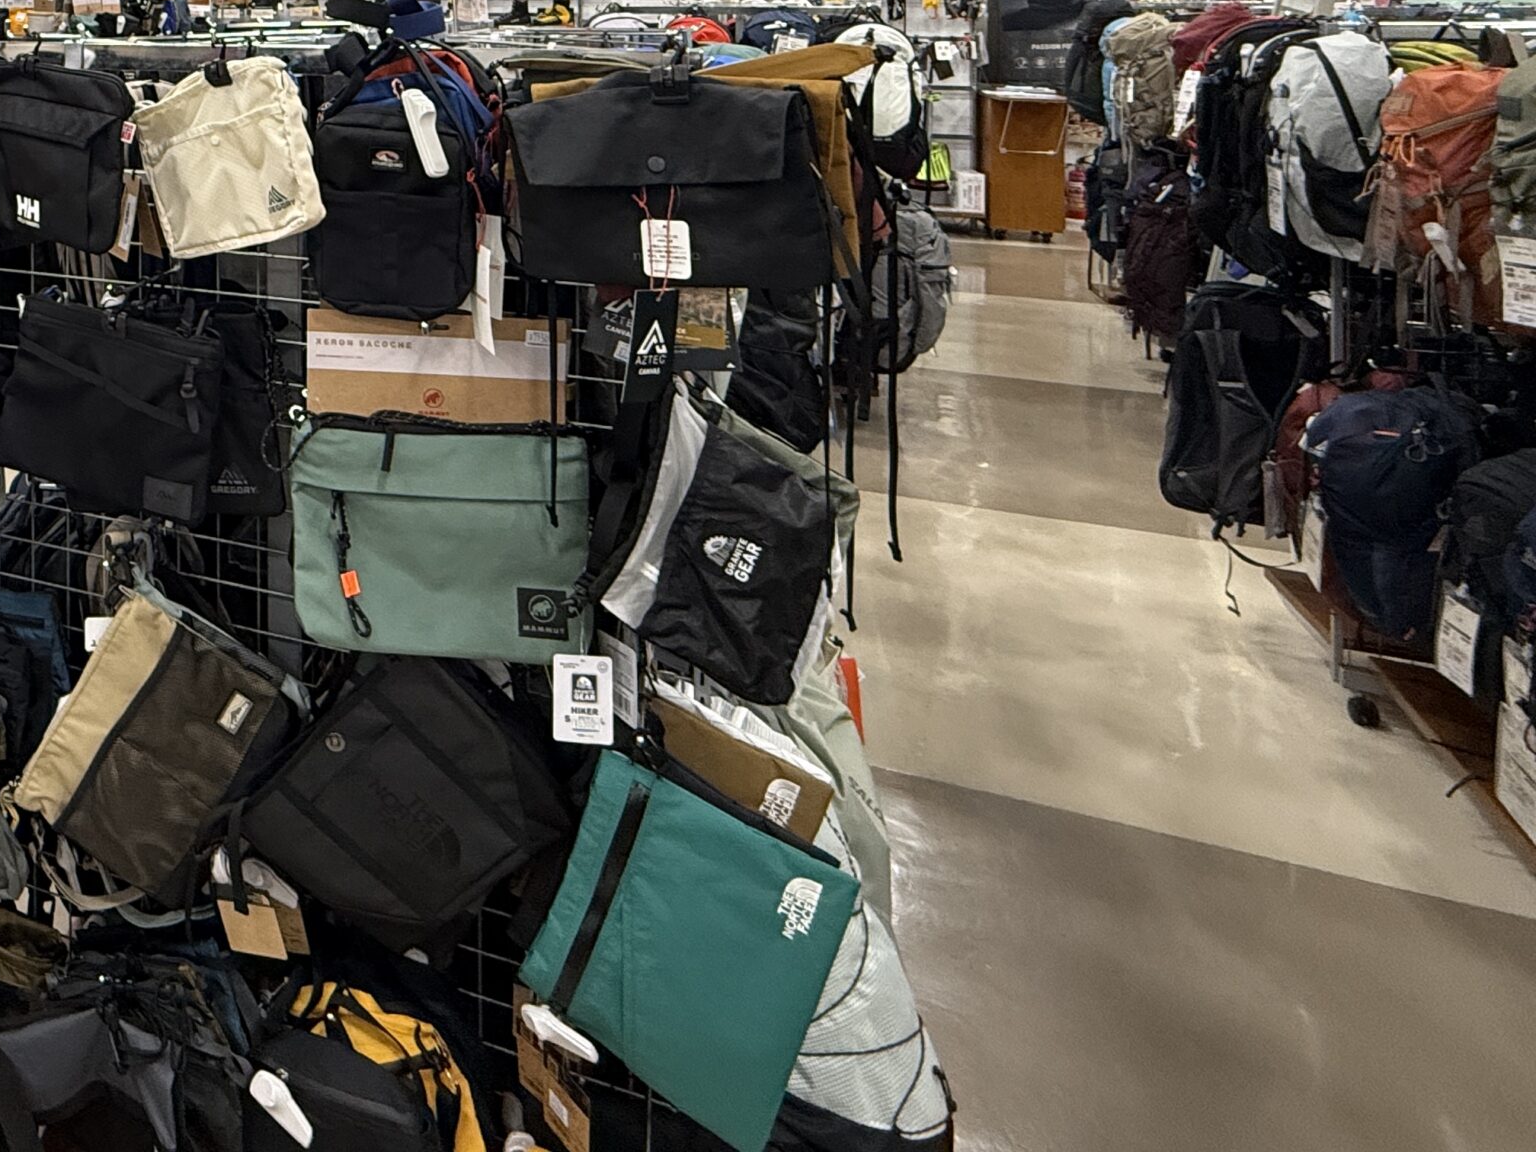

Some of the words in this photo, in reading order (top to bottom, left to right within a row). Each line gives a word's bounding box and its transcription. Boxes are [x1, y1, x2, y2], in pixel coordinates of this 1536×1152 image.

[601, 311, 633, 328] AZTE
[605, 325, 632, 338] CANVA
[316, 338, 354, 347] XERON
[359, 340, 413, 349] SACOCHE
[634, 355, 667, 365] AZTEC
[210, 485, 257, 494] GREGORY
[724, 537, 748, 576] GRANITE
[734, 542, 763, 583] GEAR
[570, 706, 599, 716] HIKER
[848, 776, 886, 826] SALO
[777, 891, 795, 915] THE
[782, 895, 805, 940] NORTH
[797, 901, 815, 936] FACE
